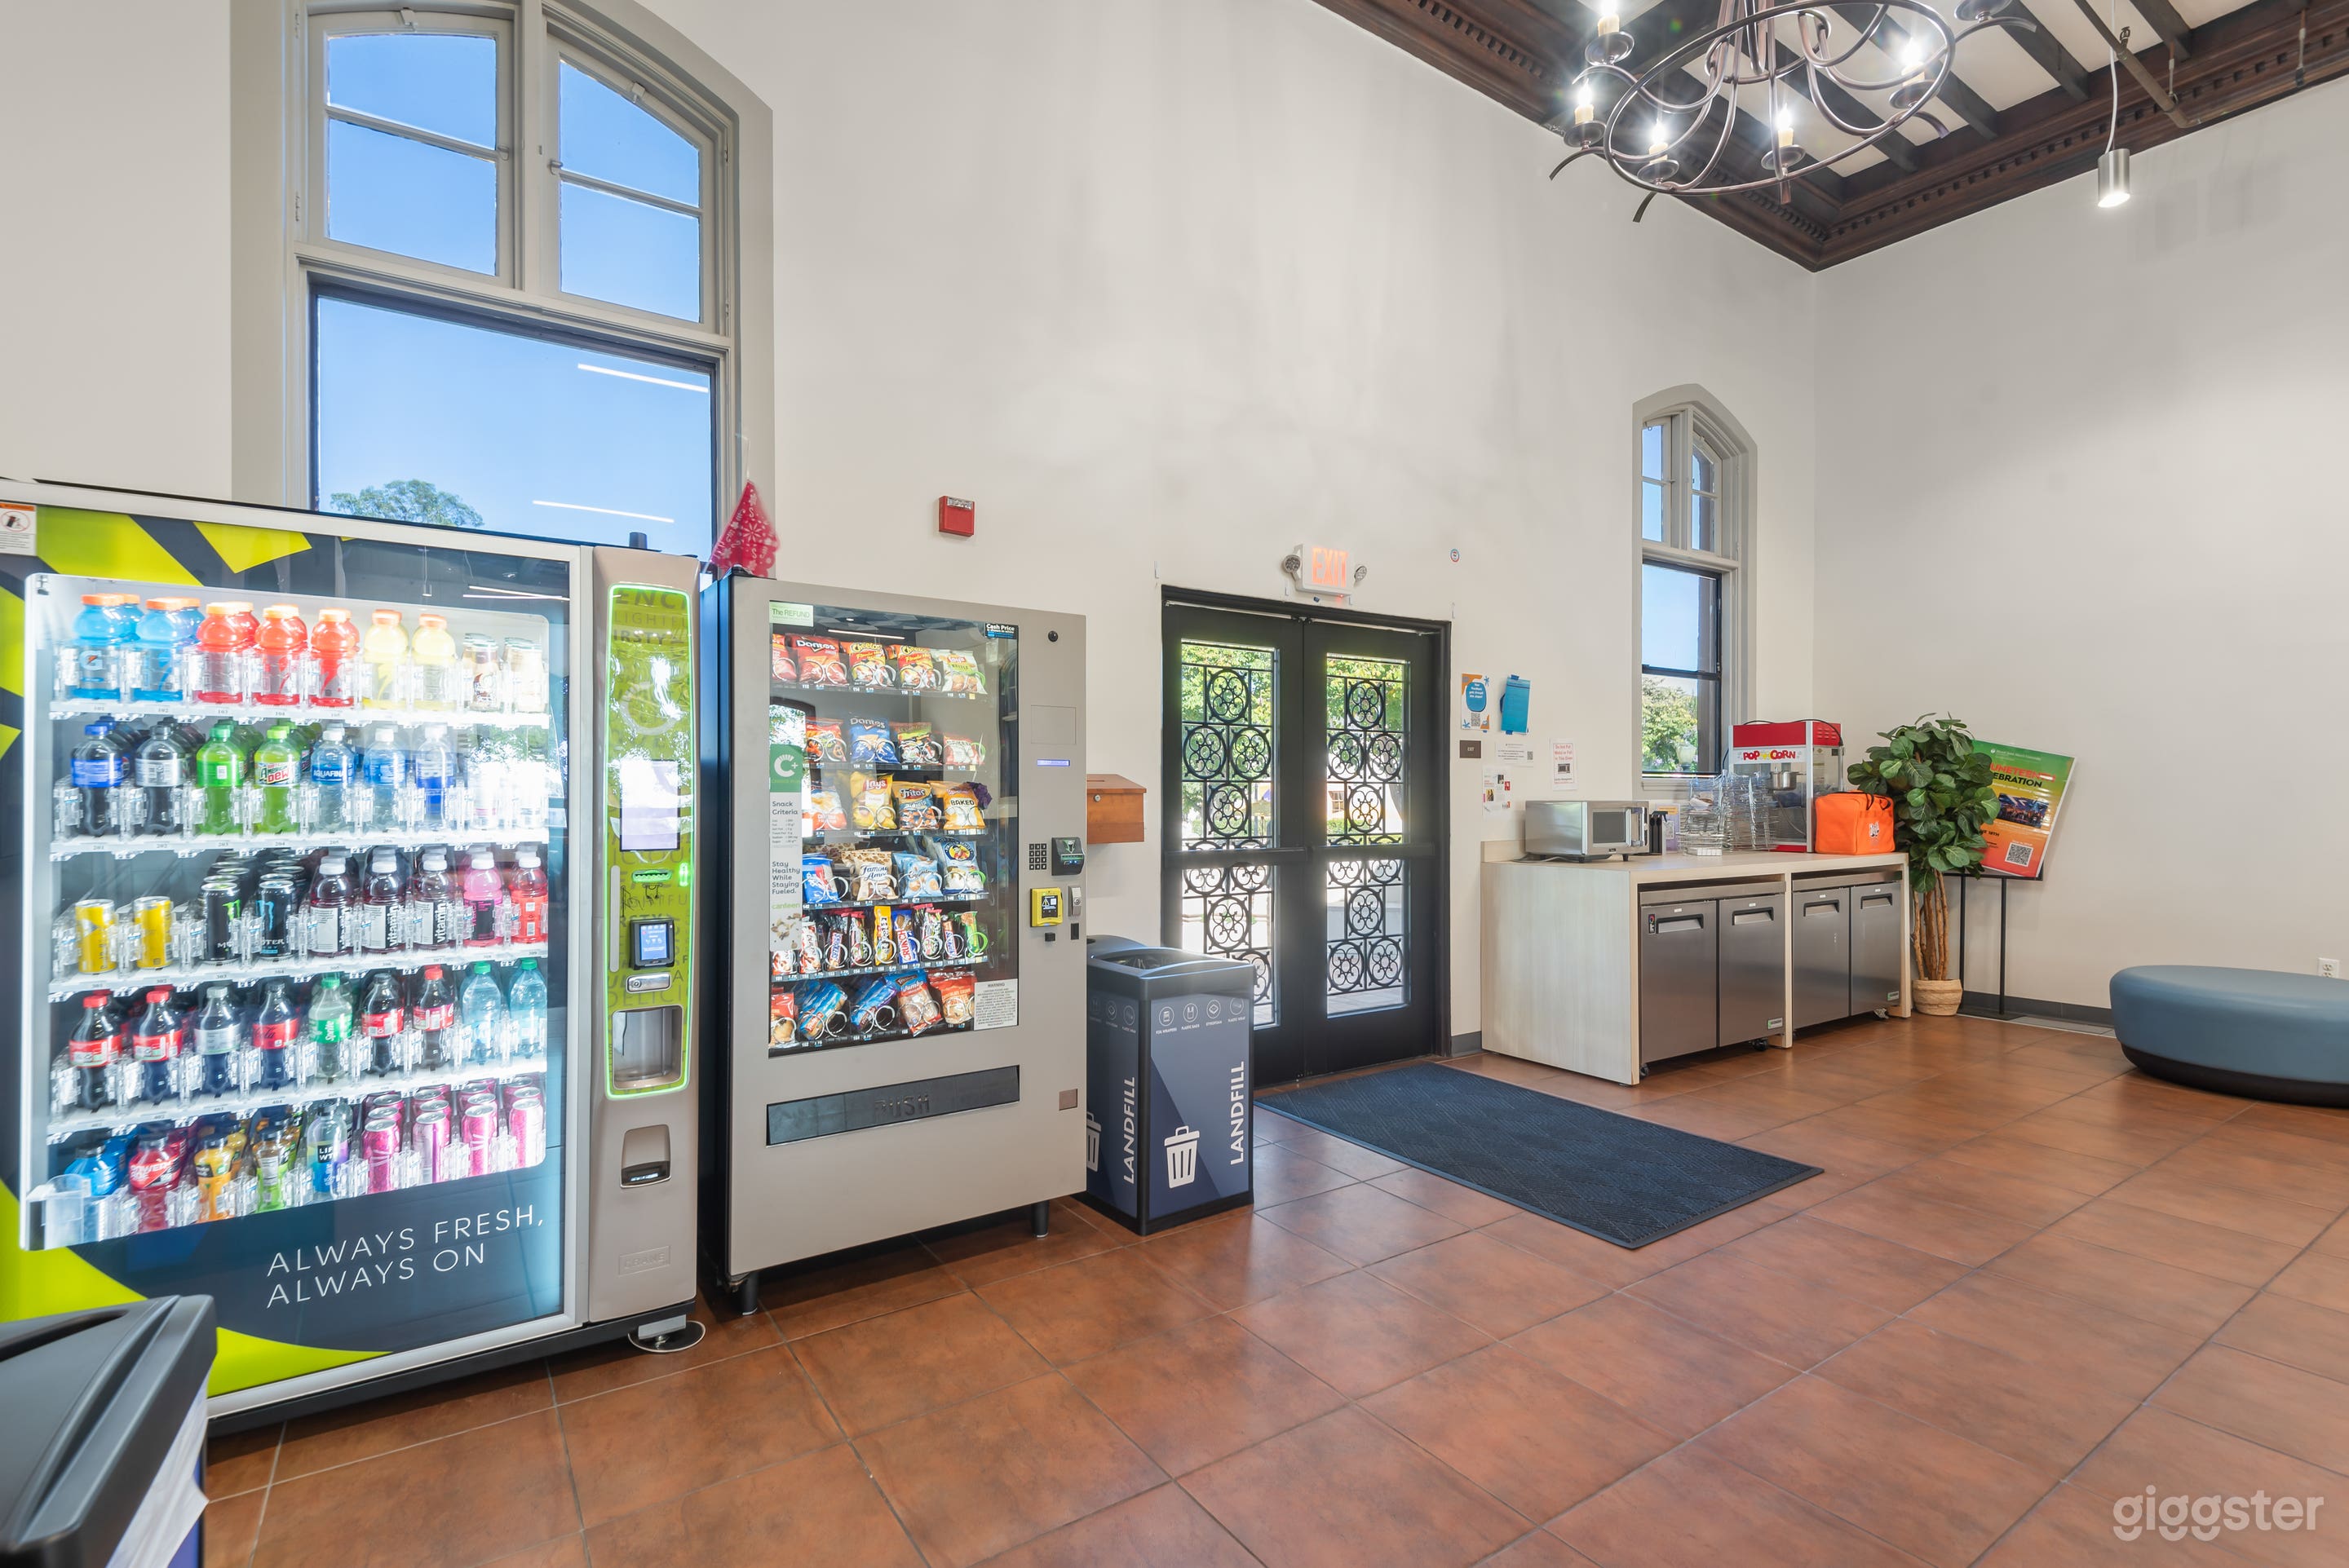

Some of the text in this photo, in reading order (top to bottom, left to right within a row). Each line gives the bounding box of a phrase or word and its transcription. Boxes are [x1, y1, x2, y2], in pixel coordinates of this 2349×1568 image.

[1311, 546, 1349, 587] EXIT
[785, 609, 810, 618] REFUND
[796, 640, 836, 651] Doritos
[852, 643, 883, 651] Cheetos
[1743, 749, 1796, 761] POP CORN
[1993, 772, 2042, 788] EBRATION
[436, 900, 447, 943] vitamin
[325, 1019, 335, 1042] Sprite
[874, 1094, 931, 1120] PUSH
[1230, 1060, 1245, 1165] LANDFILL
[1123, 1076, 1135, 1185] LANDFILL
[267, 1204, 543, 1277] ALWAYS FRESH,
[267, 1243, 484, 1309] ALWAYS ON
